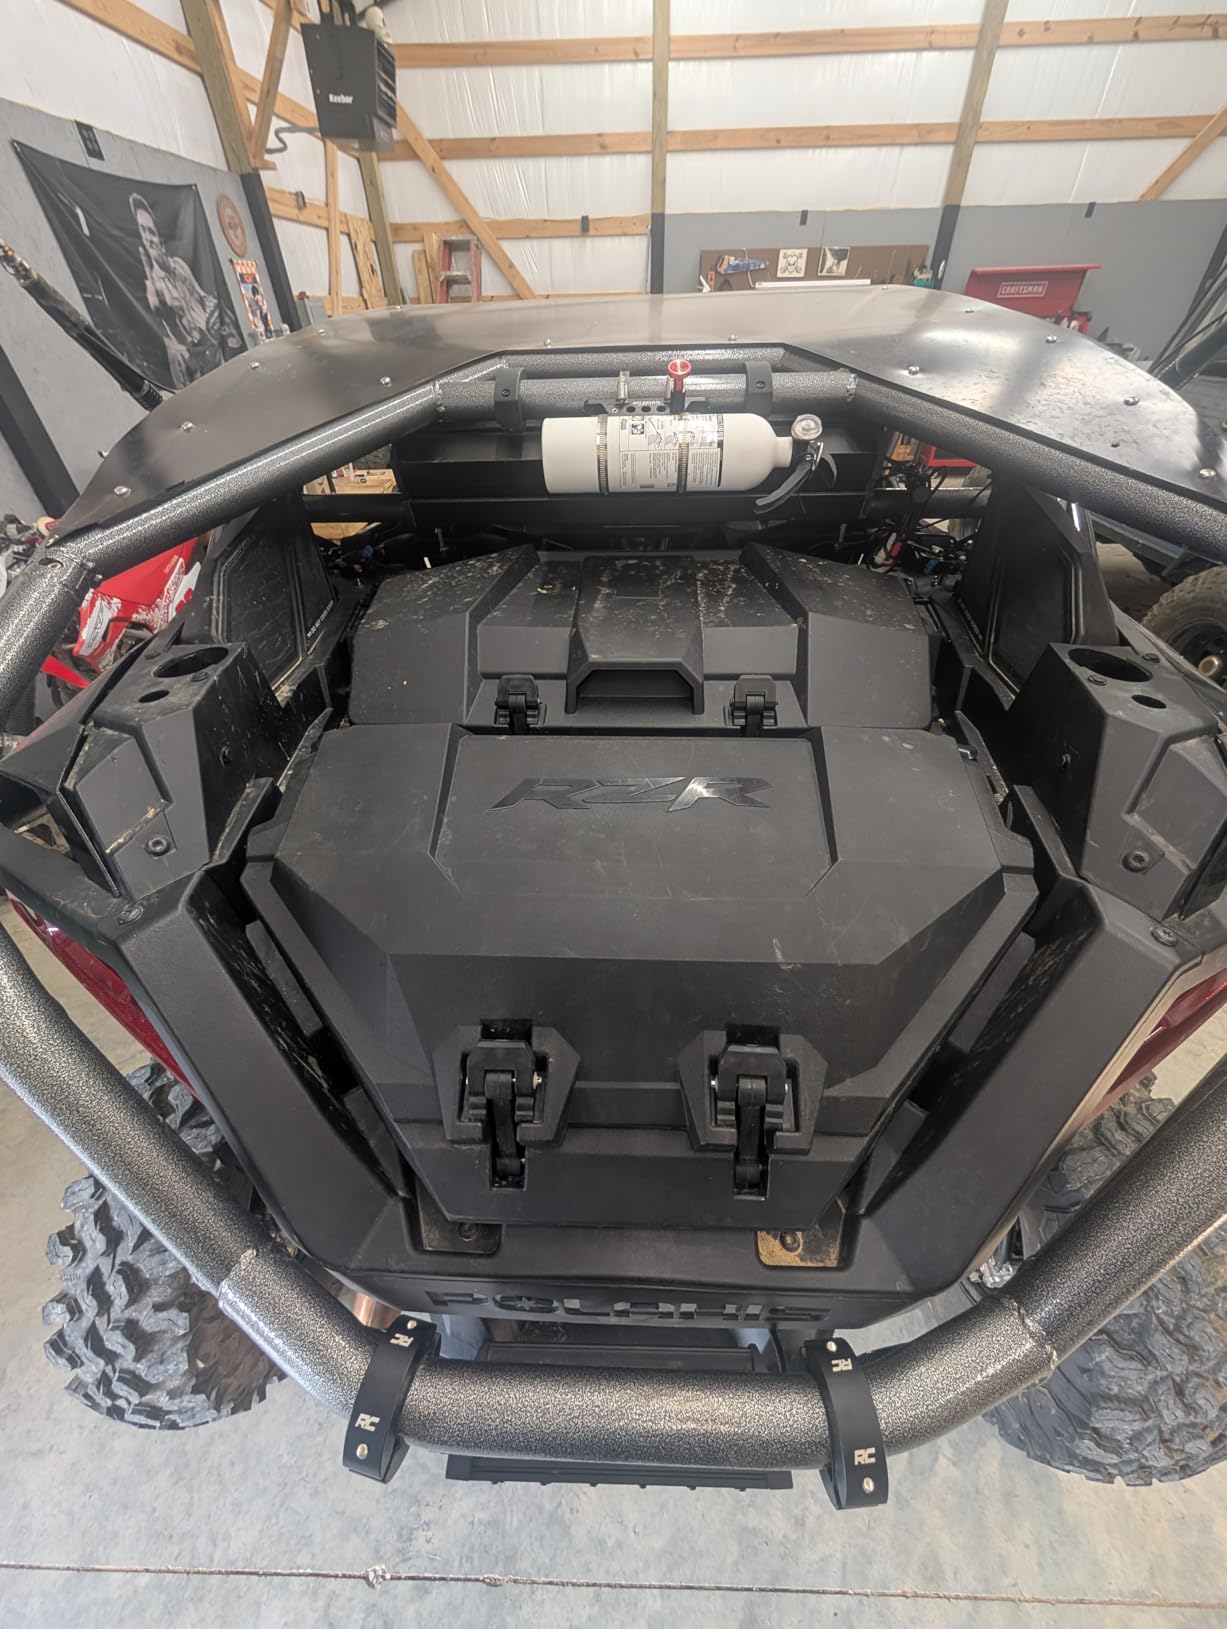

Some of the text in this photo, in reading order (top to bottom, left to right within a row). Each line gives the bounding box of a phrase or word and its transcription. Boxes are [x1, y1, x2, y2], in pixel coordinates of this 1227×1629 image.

[1000, 284, 1045, 294] CRAFTSMAN
[488, 776, 773, 812] RZR
[425, 1290, 832, 1321] POLARIS
[354, 1413, 381, 1432] RC
[854, 1447, 876, 1466] RC
